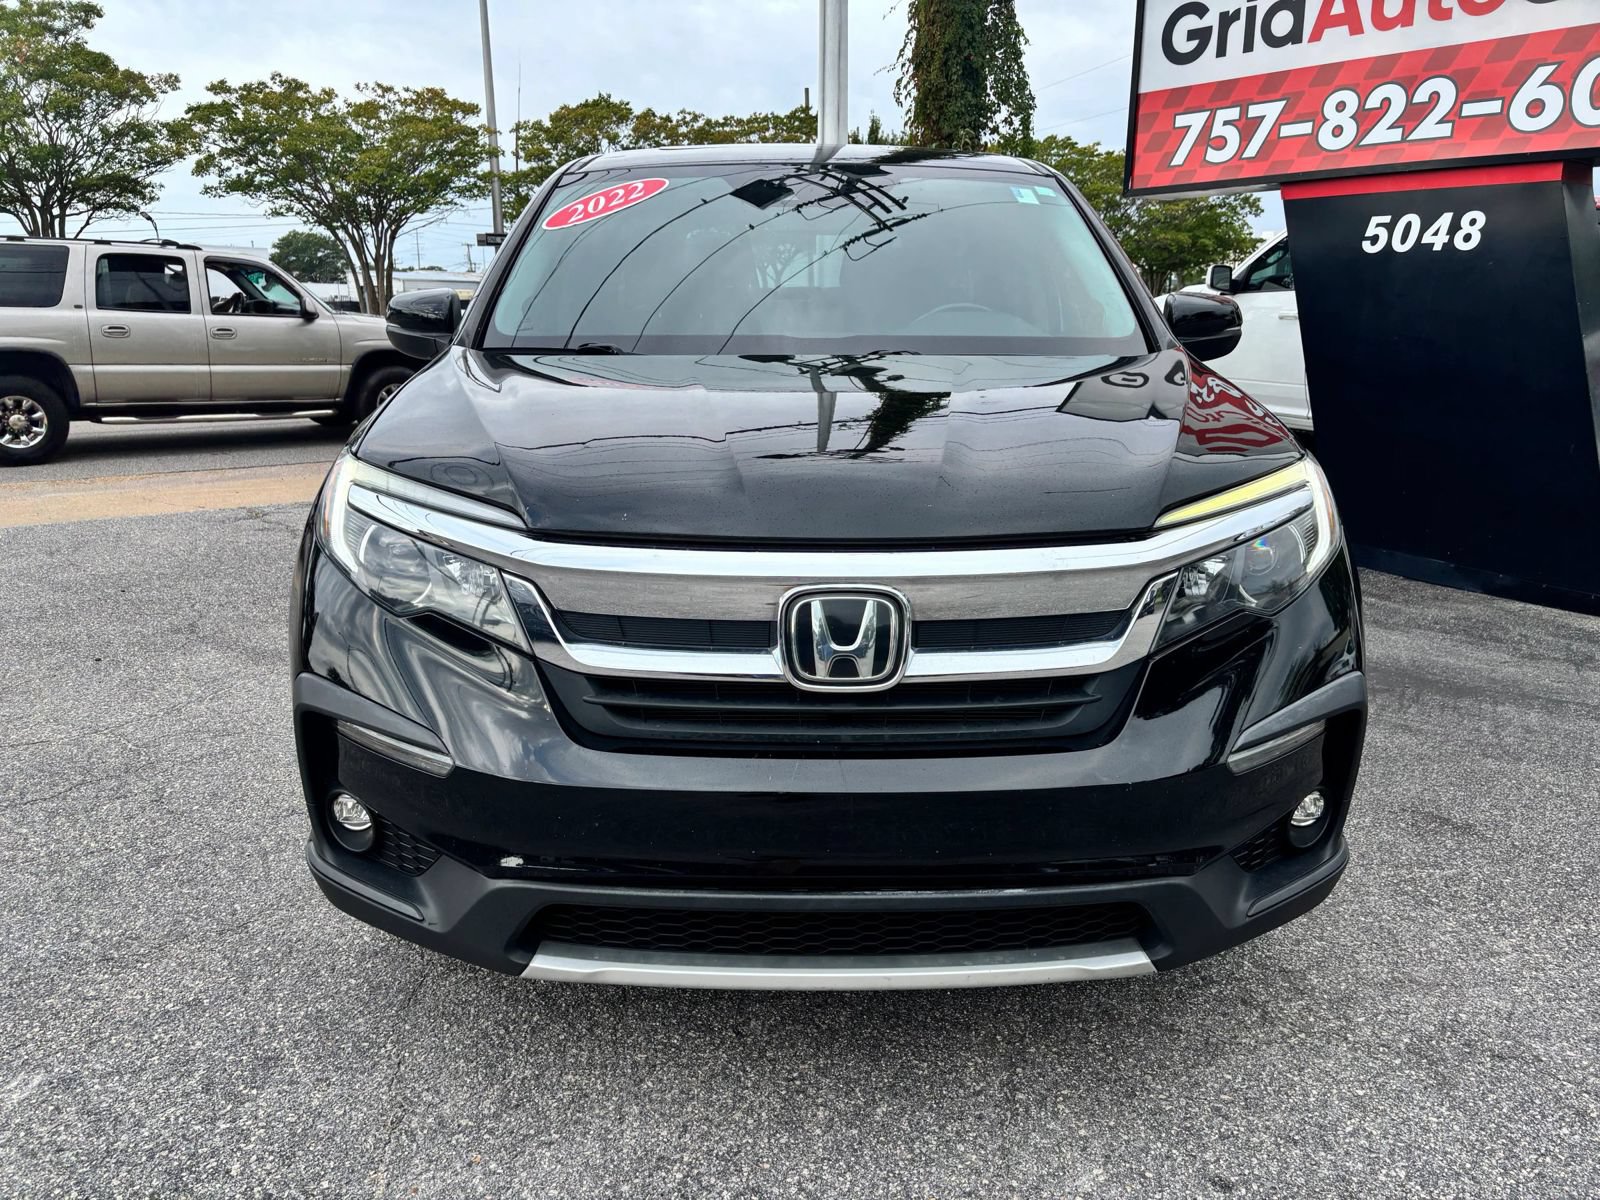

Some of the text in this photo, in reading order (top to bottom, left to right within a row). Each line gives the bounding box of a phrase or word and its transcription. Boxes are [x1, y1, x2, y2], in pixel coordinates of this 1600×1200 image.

[1161, 0, 1559, 66] GridAu
[567, 182, 645, 223] 2022
[1361, 210, 1487, 254] 5048
